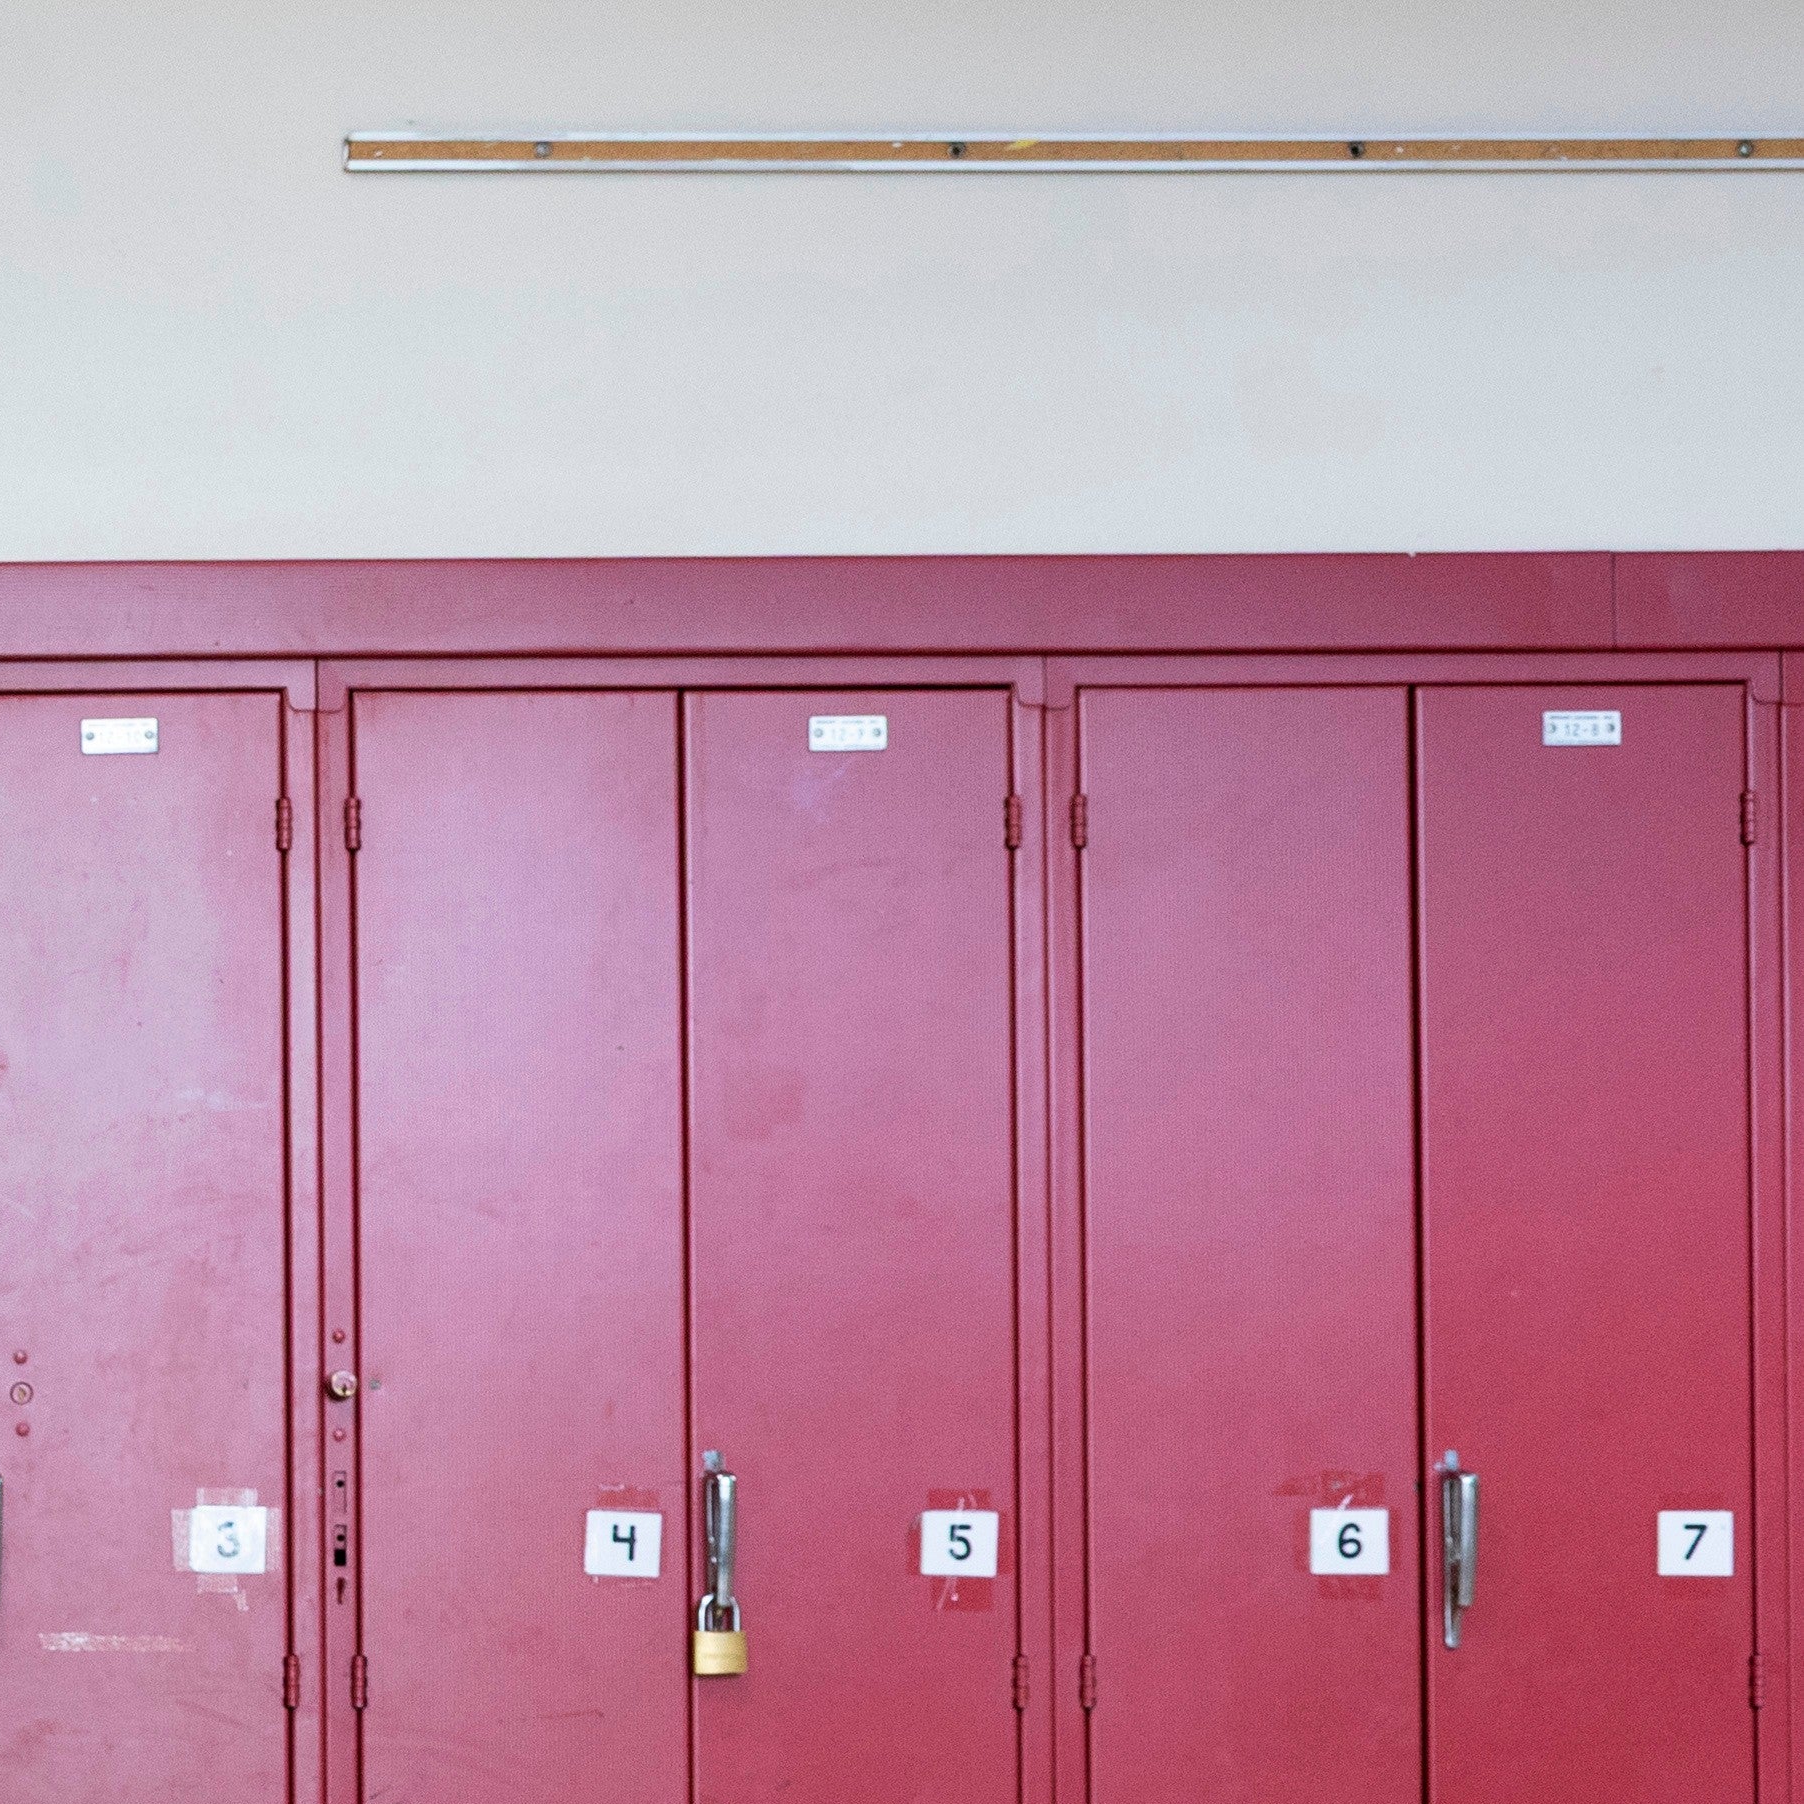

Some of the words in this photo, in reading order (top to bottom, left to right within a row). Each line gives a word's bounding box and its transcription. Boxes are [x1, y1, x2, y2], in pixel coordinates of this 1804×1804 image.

[216, 1521, 240, 1558] 3
[612, 1524, 636, 1561] 4
[949, 1524, 971, 1560] 5
[1338, 1523, 1362, 1559] 6
[1684, 1524, 1707, 1560] 7
